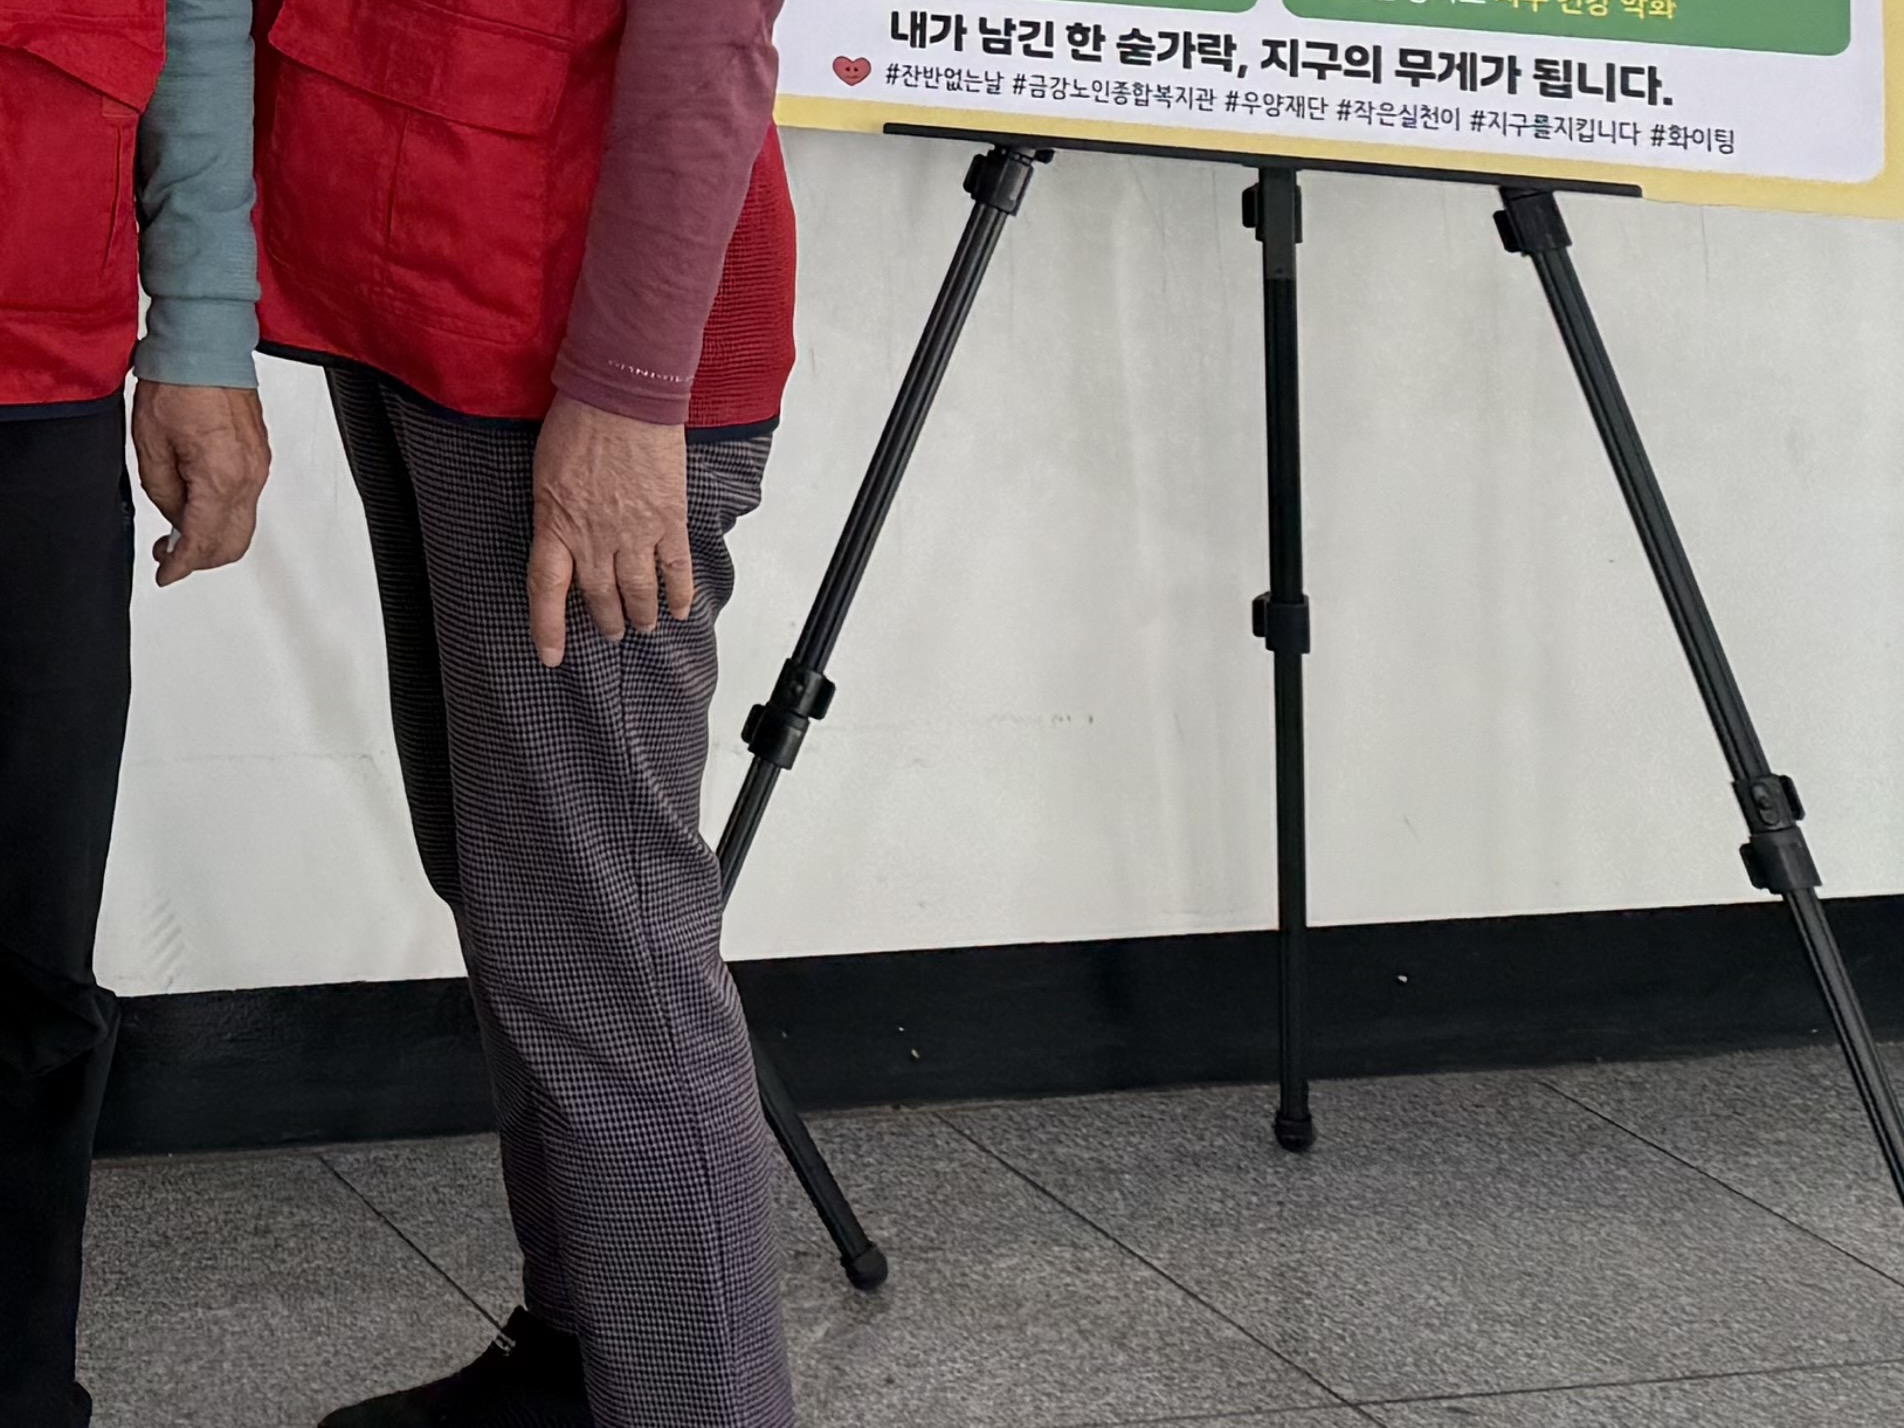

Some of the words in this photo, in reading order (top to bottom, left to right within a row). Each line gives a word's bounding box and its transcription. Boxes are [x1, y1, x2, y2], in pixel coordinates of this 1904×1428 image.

[891, 10, 967, 51] 내가
[978, 16, 1054, 58] 남긴
[1066, 21, 1106, 62] 한
[1116, 27, 1248, 78] 숟가락,
[1261, 38, 1382, 84] 지구의
[1395, 47, 1522, 94] 무게가
[1533, 57, 1674, 106] 됩니다.
[885, 63, 1005, 96] #잔반없는날
[1012, 73, 1217, 113] #금강노인종합복지관
[1225, 88, 1329, 121] #우양재단
[1337, 99, 1461, 132] #작은실천이
[1470, 109, 1641, 145] #지구를지킵니다
[1650, 123, 1735, 155] #화이팅
